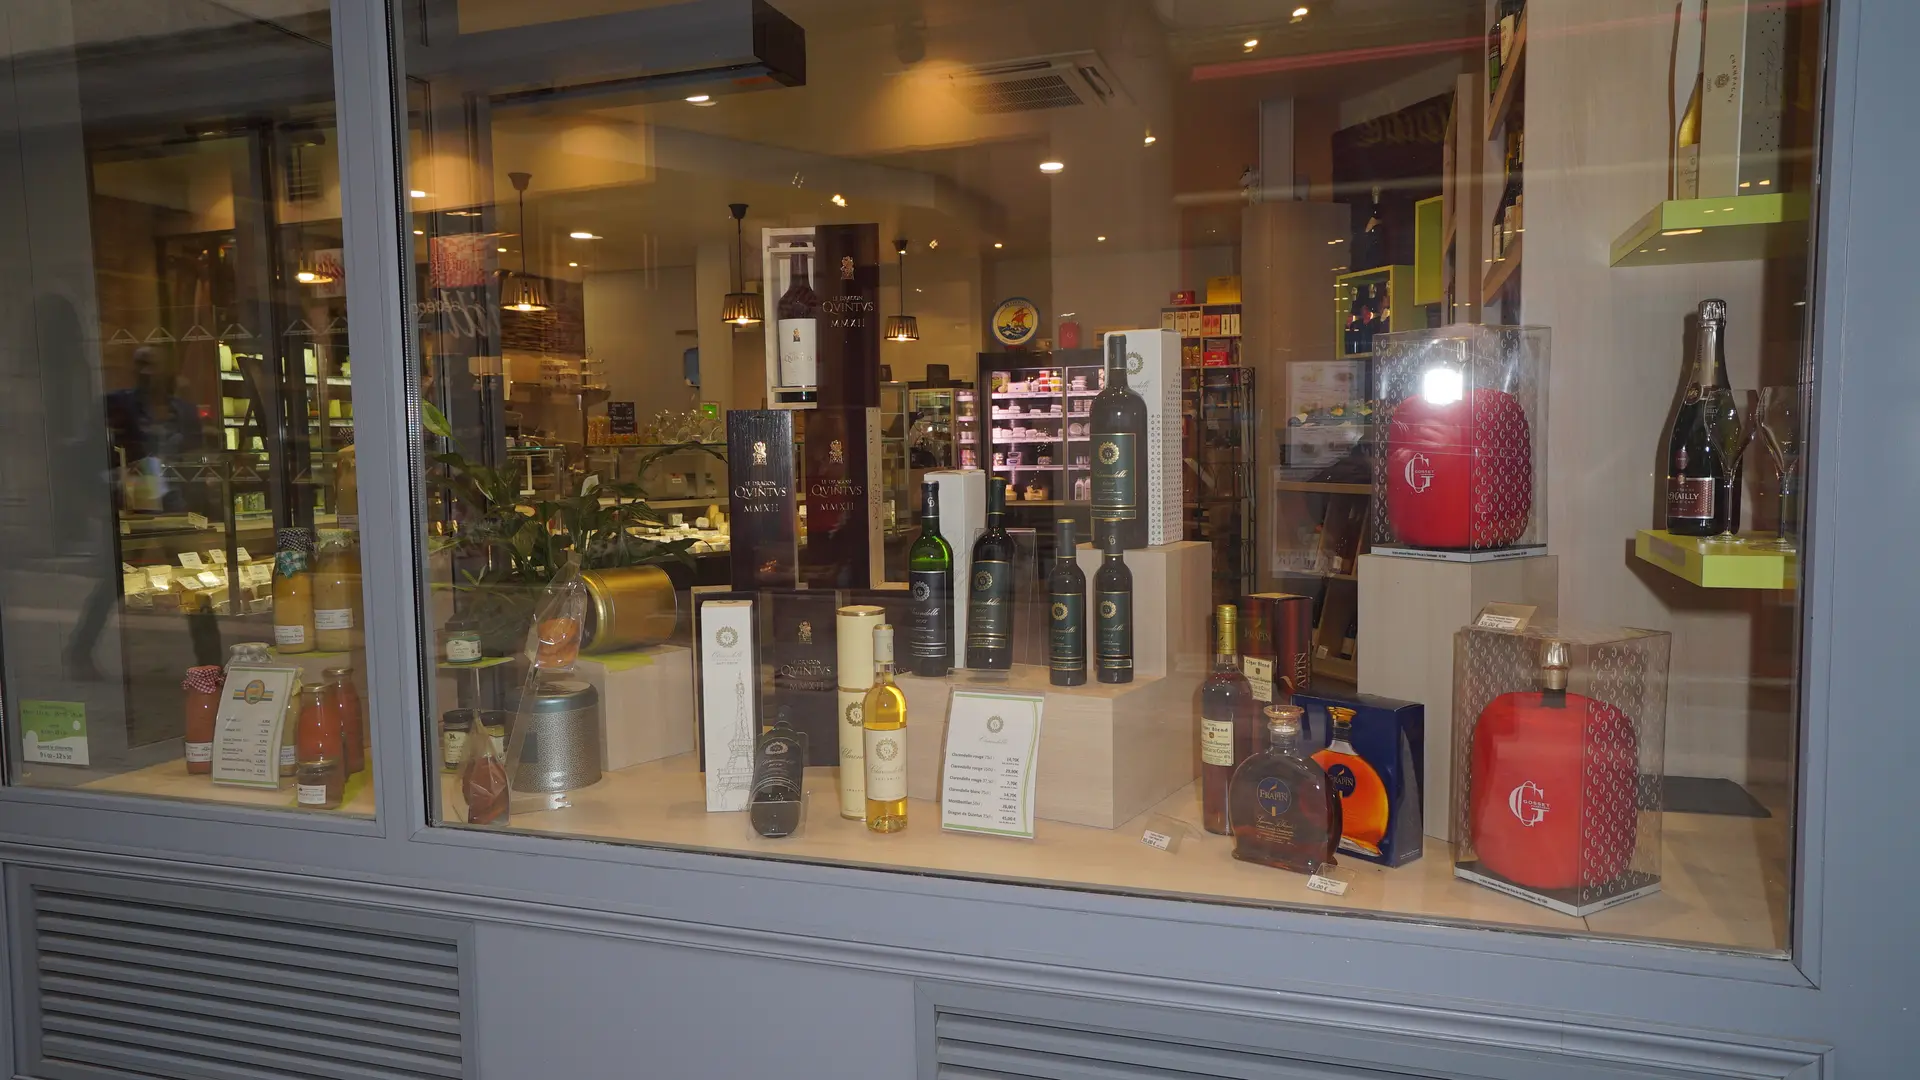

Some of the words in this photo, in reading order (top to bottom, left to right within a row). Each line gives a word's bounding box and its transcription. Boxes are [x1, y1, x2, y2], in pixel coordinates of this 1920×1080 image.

[822, 301, 874, 315] QVINTVS
[734, 485, 787, 499] QVINTVS
[810, 484, 863, 499] QVINTVS
[743, 503, 780, 513] MMXII
[820, 502, 855, 511] MMXII
[781, 664, 832, 678] QVINTVS
[1296, 652, 1307, 689] APIN
[1259, 789, 1288, 802] FRAPIN
[1523, 799, 1550, 807] GOSSET
